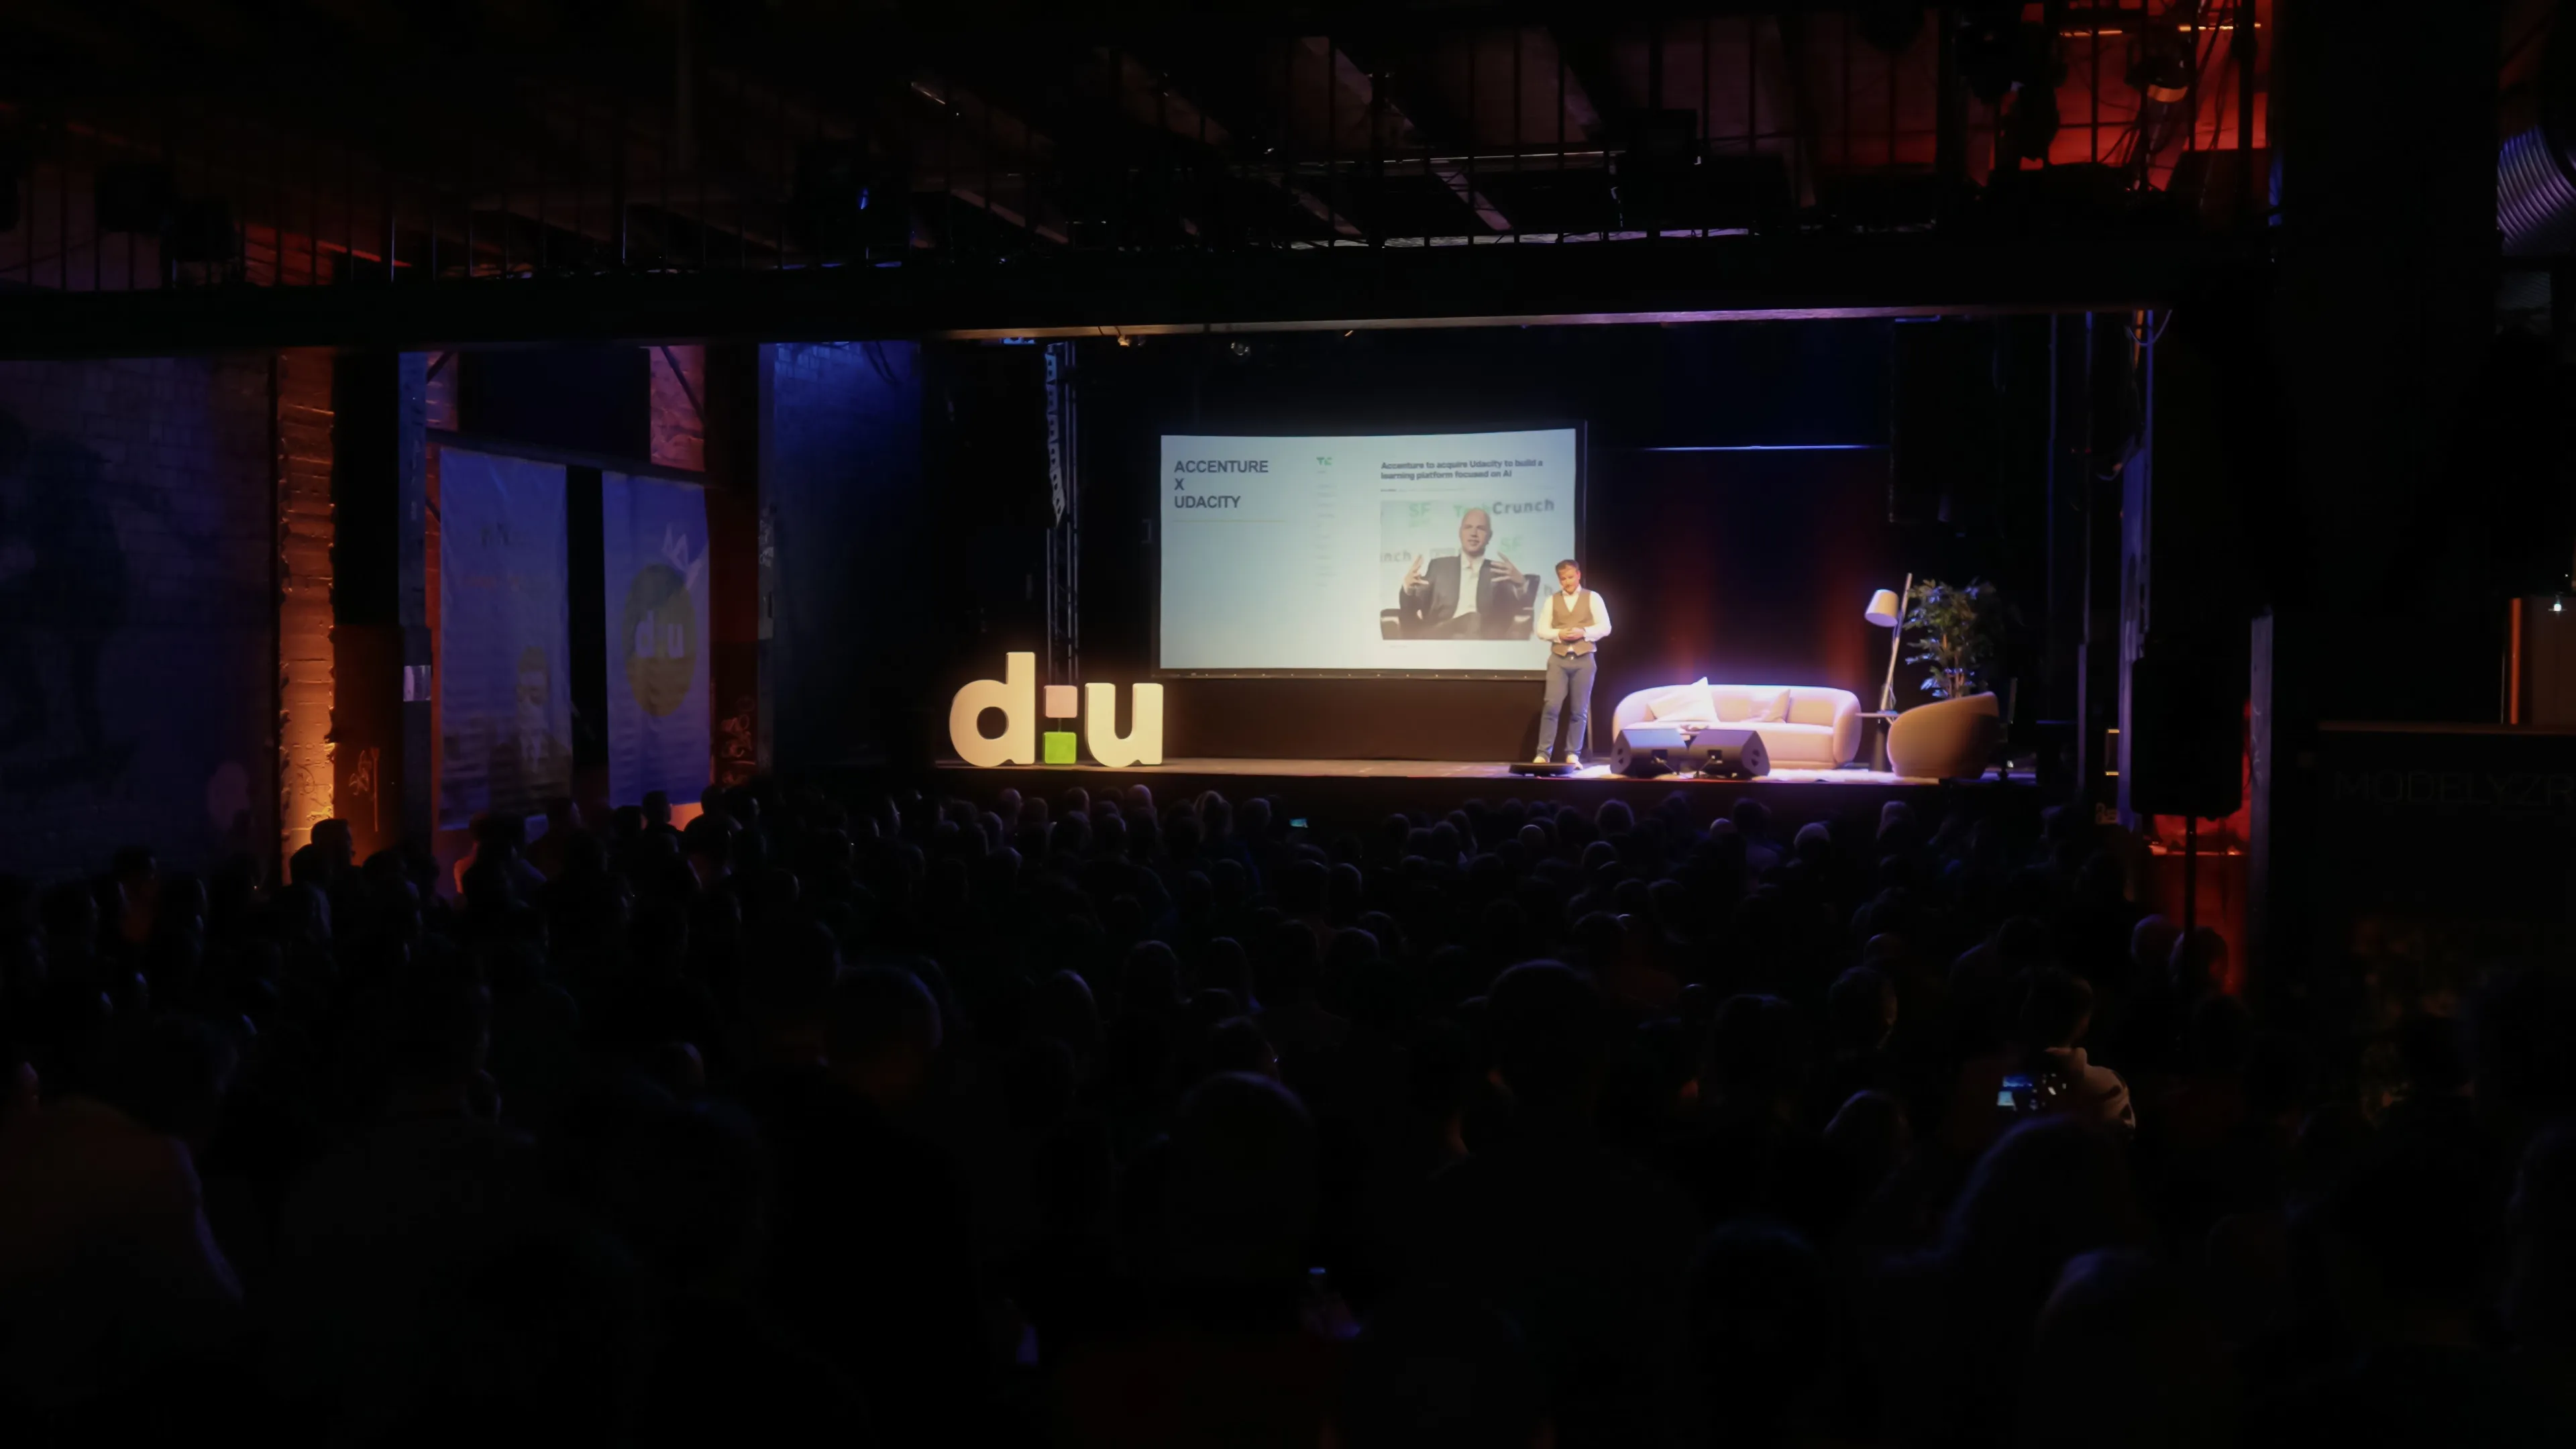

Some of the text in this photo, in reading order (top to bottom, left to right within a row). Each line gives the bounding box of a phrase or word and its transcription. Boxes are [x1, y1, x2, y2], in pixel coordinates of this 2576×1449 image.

[1174, 460, 1269, 473] ACCENTURE
[1437, 461, 1467, 469] acquire
[1470, 460, 1502, 468] Udacity
[1381, 472, 1415, 480] learning
[1416, 471, 1452, 480] platform
[1455, 470, 1489, 478] focused
[1175, 496, 1240, 508] UDACITY
